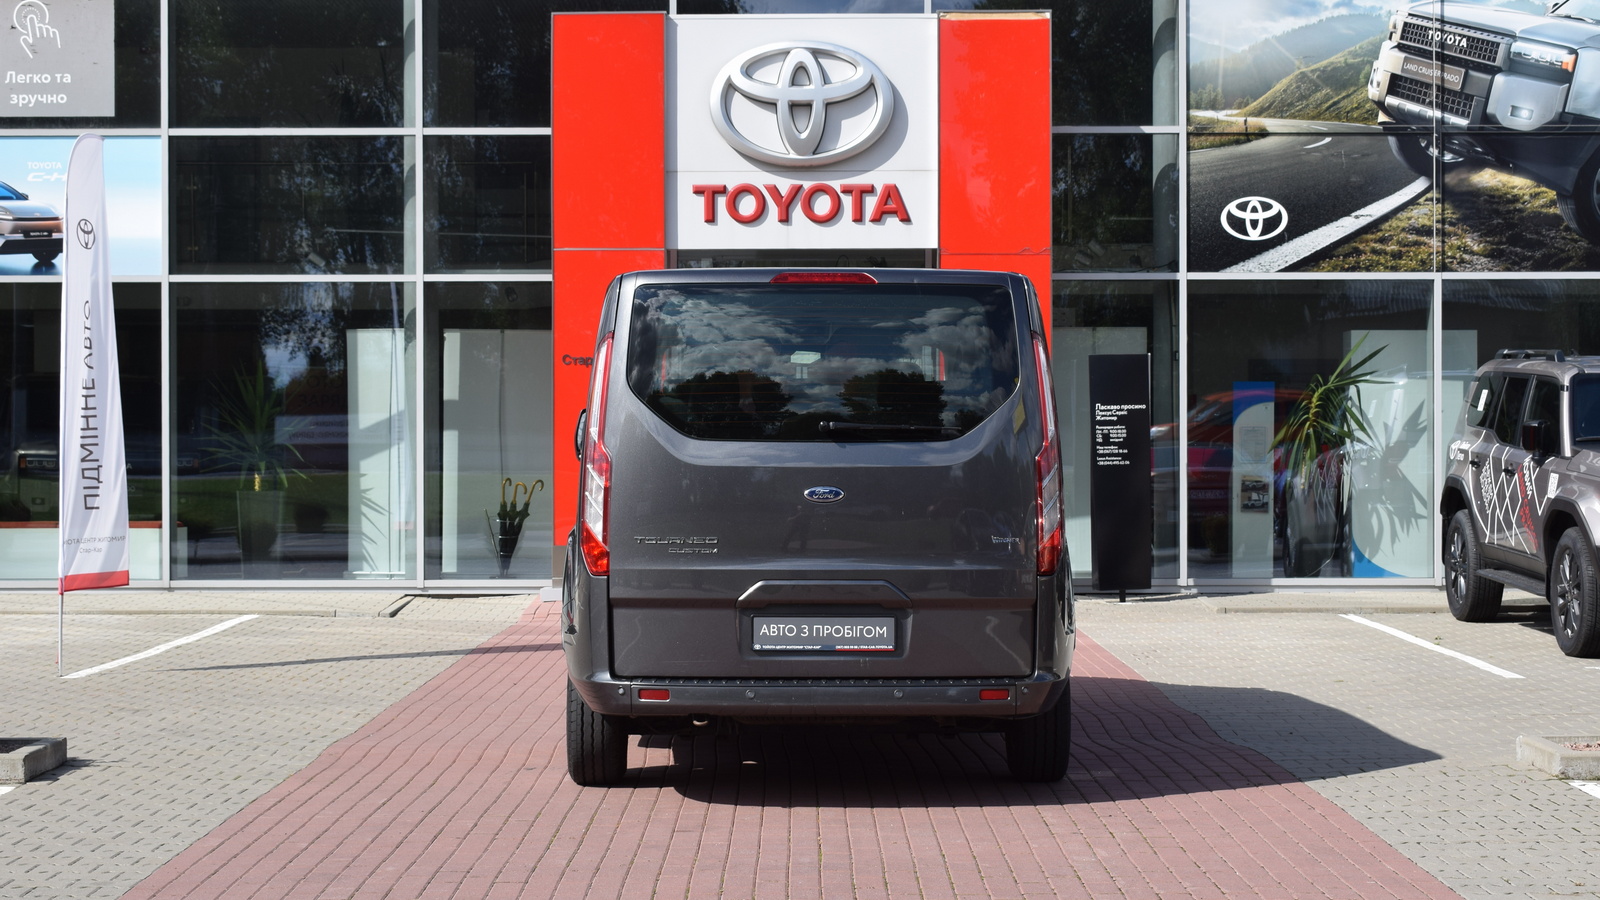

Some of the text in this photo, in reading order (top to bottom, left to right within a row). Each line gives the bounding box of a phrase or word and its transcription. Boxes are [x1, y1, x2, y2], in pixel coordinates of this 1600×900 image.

[1428, 30, 1467, 48] TOYOTA
[1403, 62, 1418, 72] LAND
[1418, 65, 1441, 77] CRUISER
[4, 70, 72, 84] Легко та
[9, 93, 67, 107] зручно
[27, 161, 62, 169] TOYOTA
[27, 172, 68, 181] C-H
[692, 183, 912, 224] TOYOTA
[80, 300, 103, 511] ПІДМІННЕ АВТО
[812, 490, 836, 499] Ford
[634, 536, 718, 544] TOURNEO
[759, 624, 797, 637] АВТО
[813, 625, 887, 638] ПРОБІГОМ
